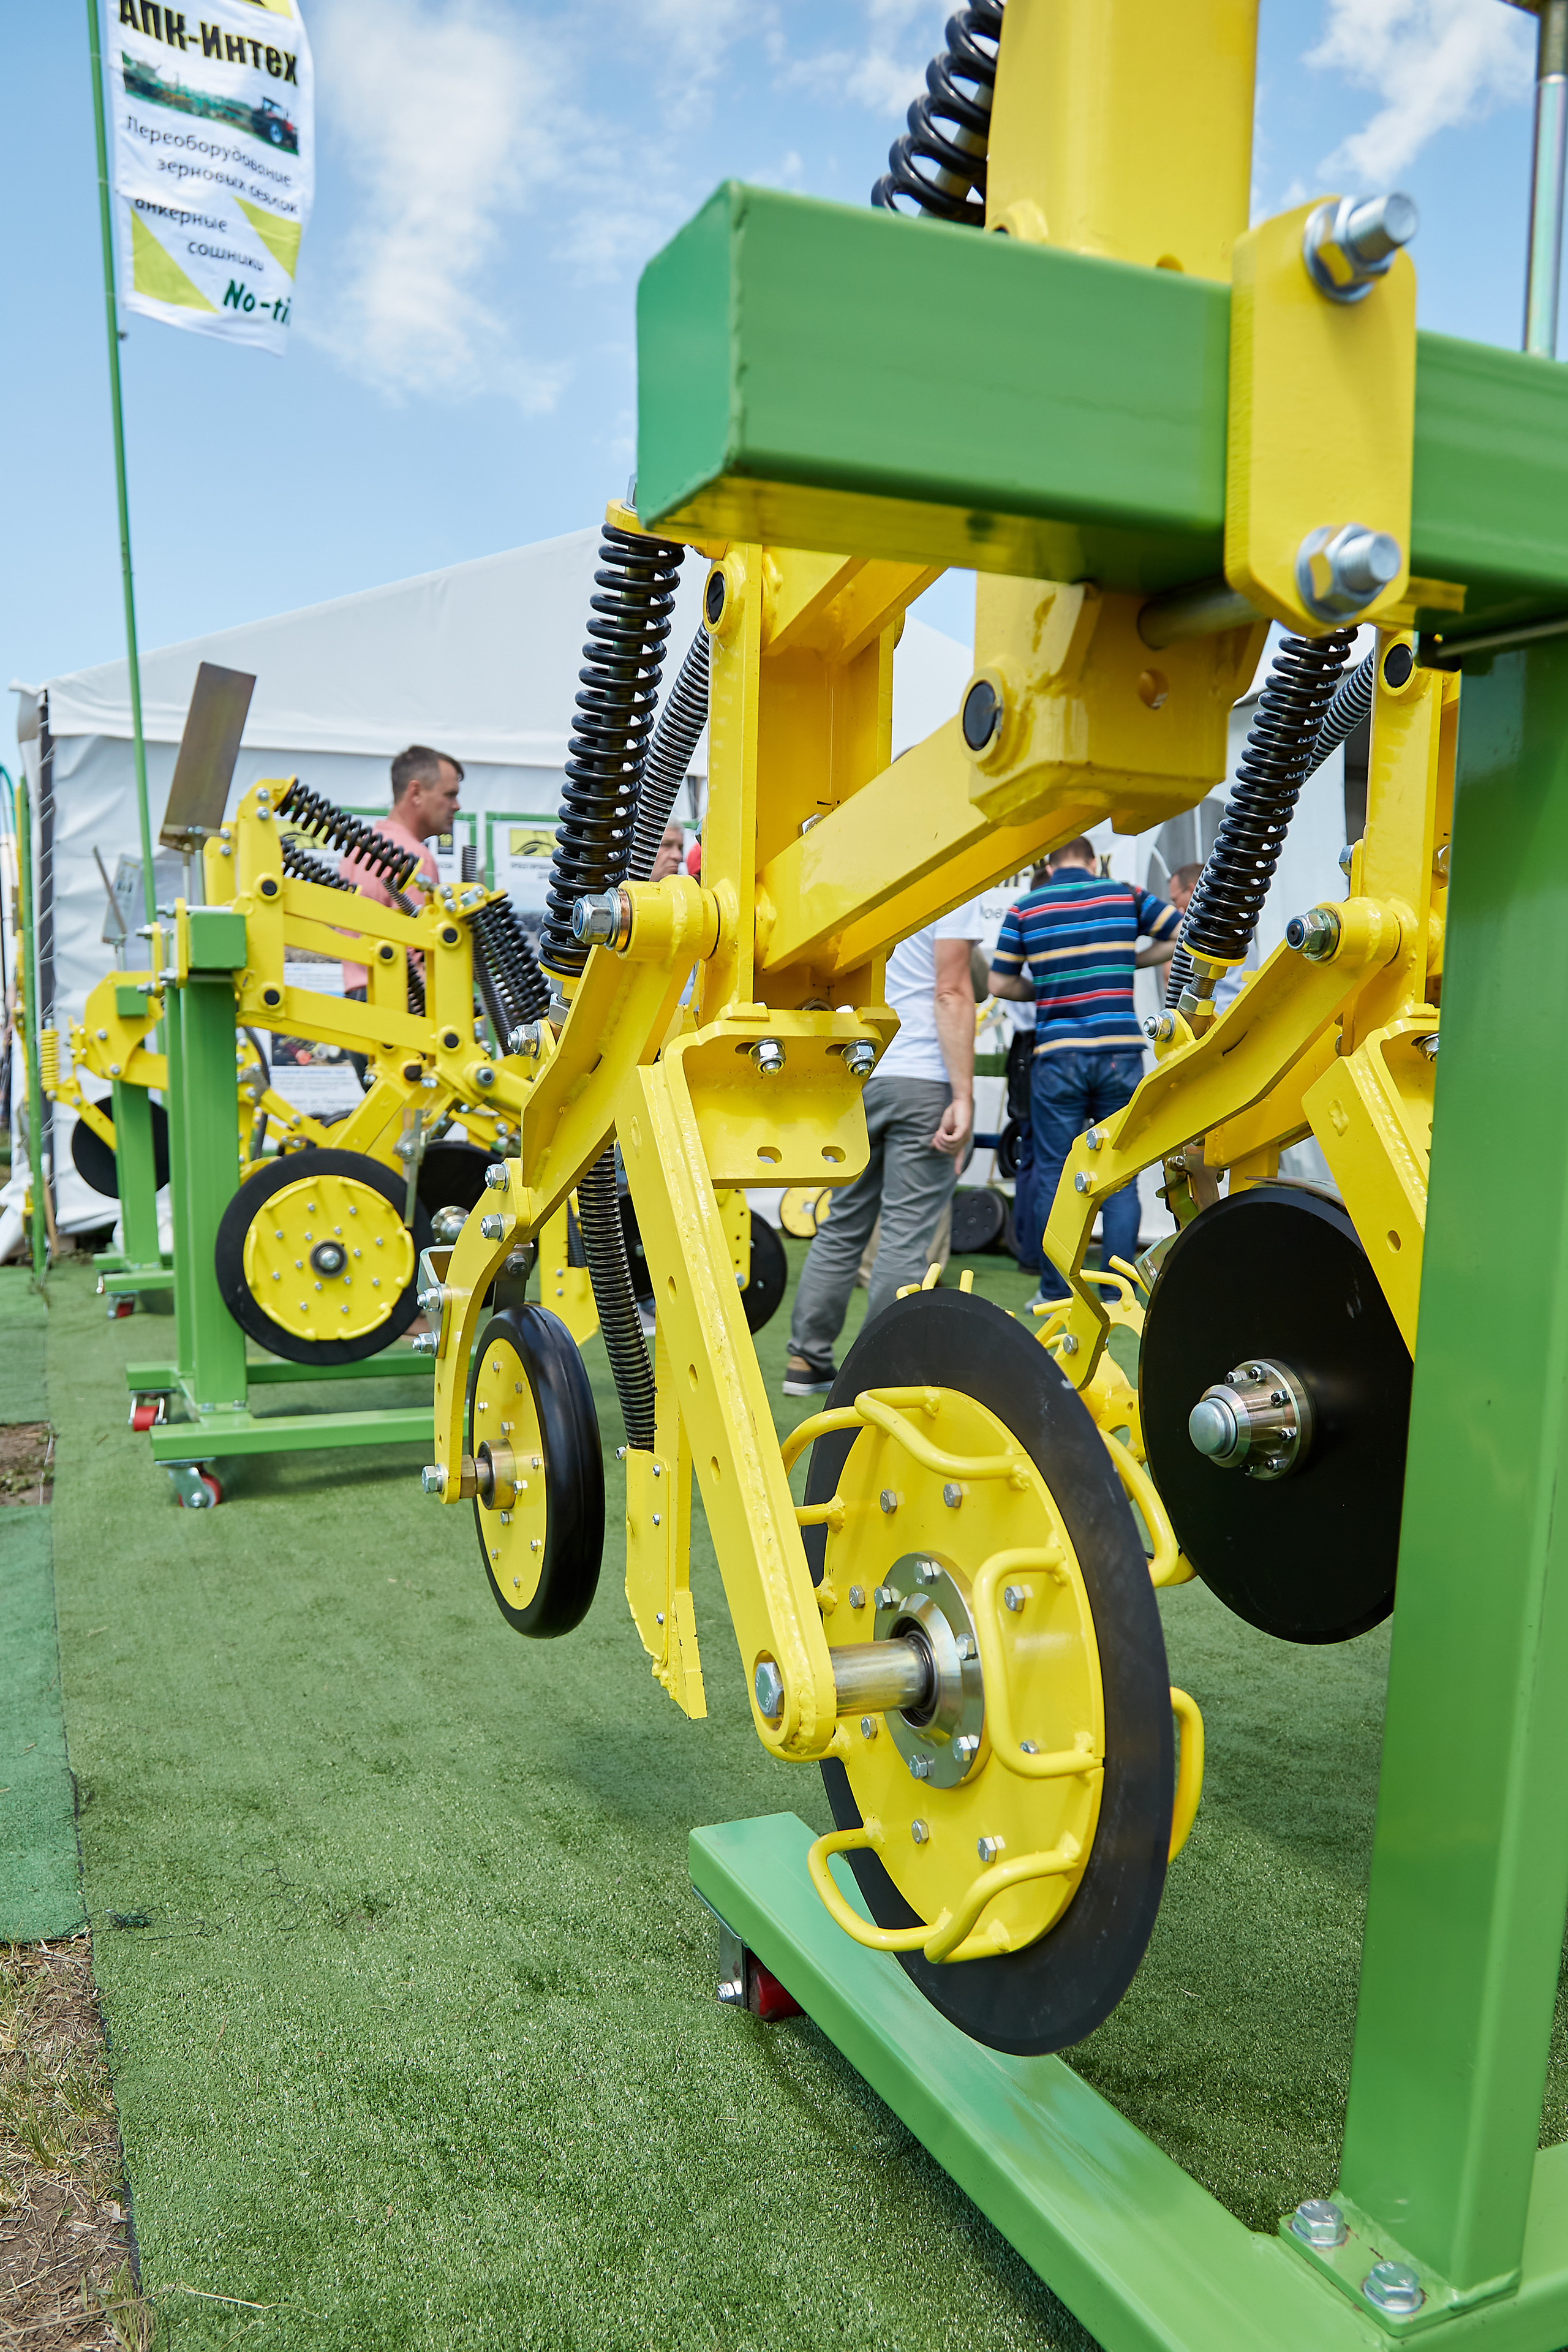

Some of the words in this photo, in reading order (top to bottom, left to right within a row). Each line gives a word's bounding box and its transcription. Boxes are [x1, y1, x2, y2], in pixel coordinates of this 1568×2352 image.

[119, 0, 298, 86] АПК-Интех
[127, 115, 292, 186] Переоборудование
[157, 158, 246, 190] зерновых
[249, 184, 298, 214] сеялок
[134, 198, 228, 233] анкерные
[187, 241, 265, 271] сошники
[223, 279, 291, 325] No-ti
